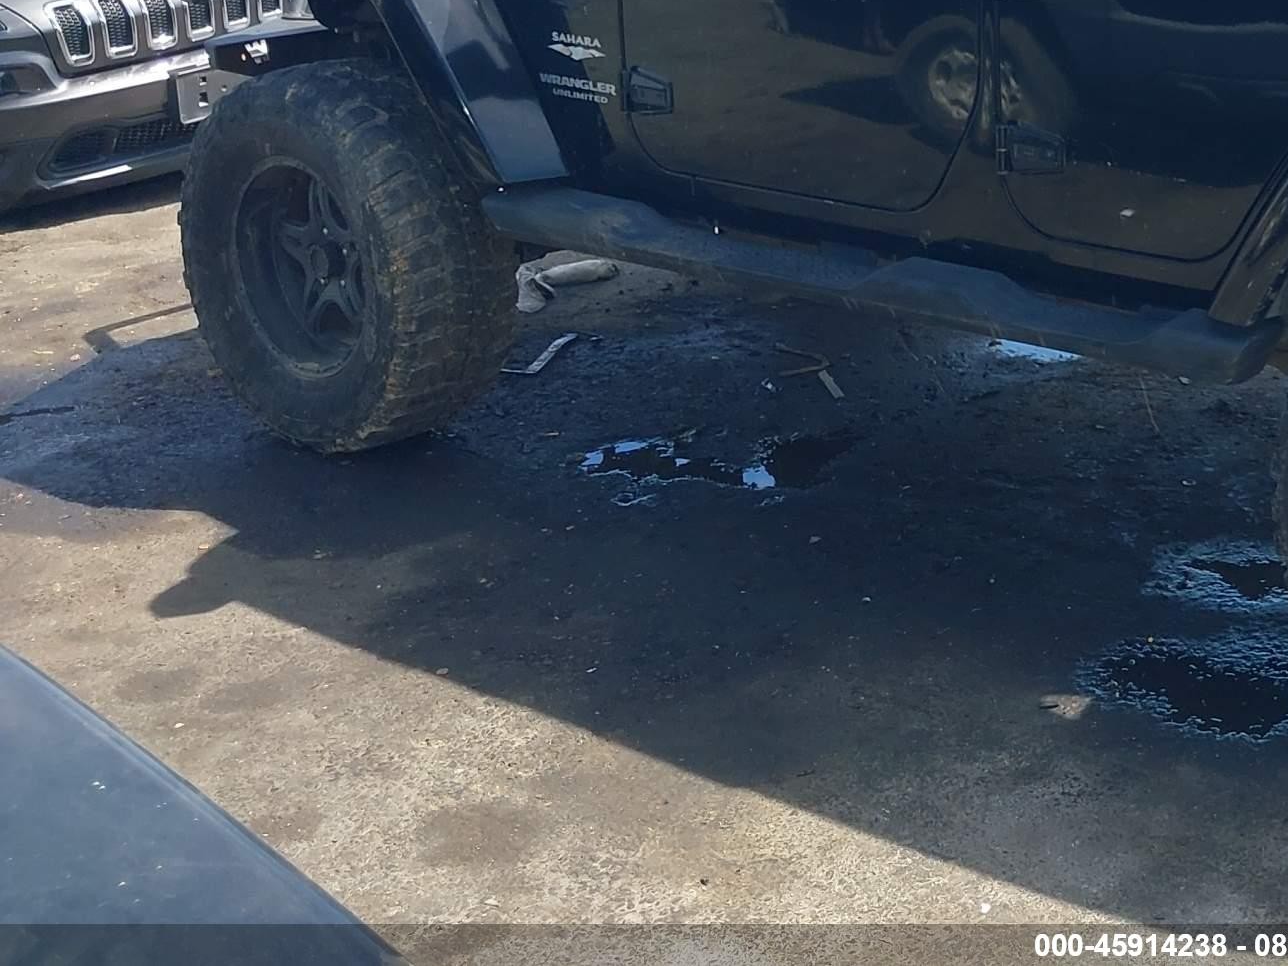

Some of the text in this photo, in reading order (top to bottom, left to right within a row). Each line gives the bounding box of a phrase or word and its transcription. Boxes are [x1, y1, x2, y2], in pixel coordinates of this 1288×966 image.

[551, 31, 601, 48] SAHARA
[540, 72, 617, 96] WRANGLER
[552, 87, 609, 104] UNLIMITED
